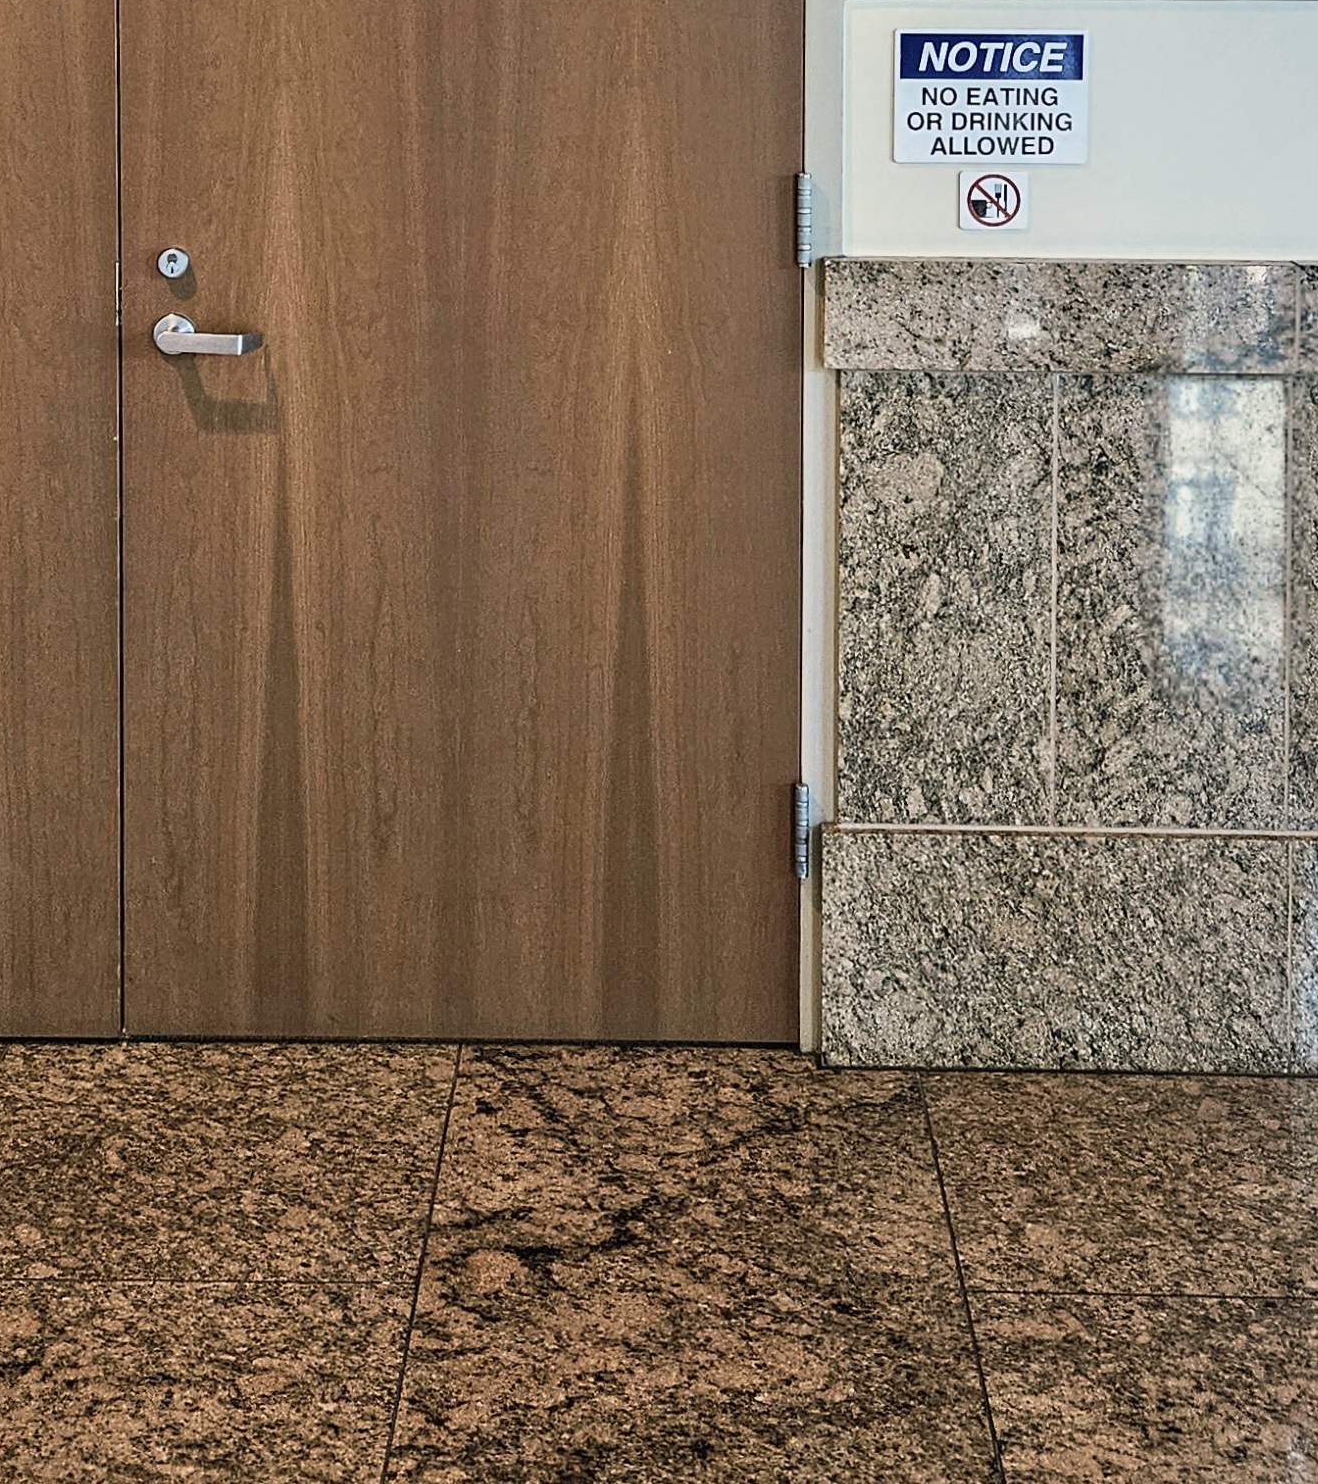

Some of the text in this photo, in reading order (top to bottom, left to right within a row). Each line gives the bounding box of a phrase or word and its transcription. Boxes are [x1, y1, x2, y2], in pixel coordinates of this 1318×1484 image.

[918, 41, 1068, 73] NOTICE
[921, 87, 1059, 106] NO EATING
[907, 112, 1073, 131] OR DRINKING
[930, 136, 1055, 156] ALLOWED
